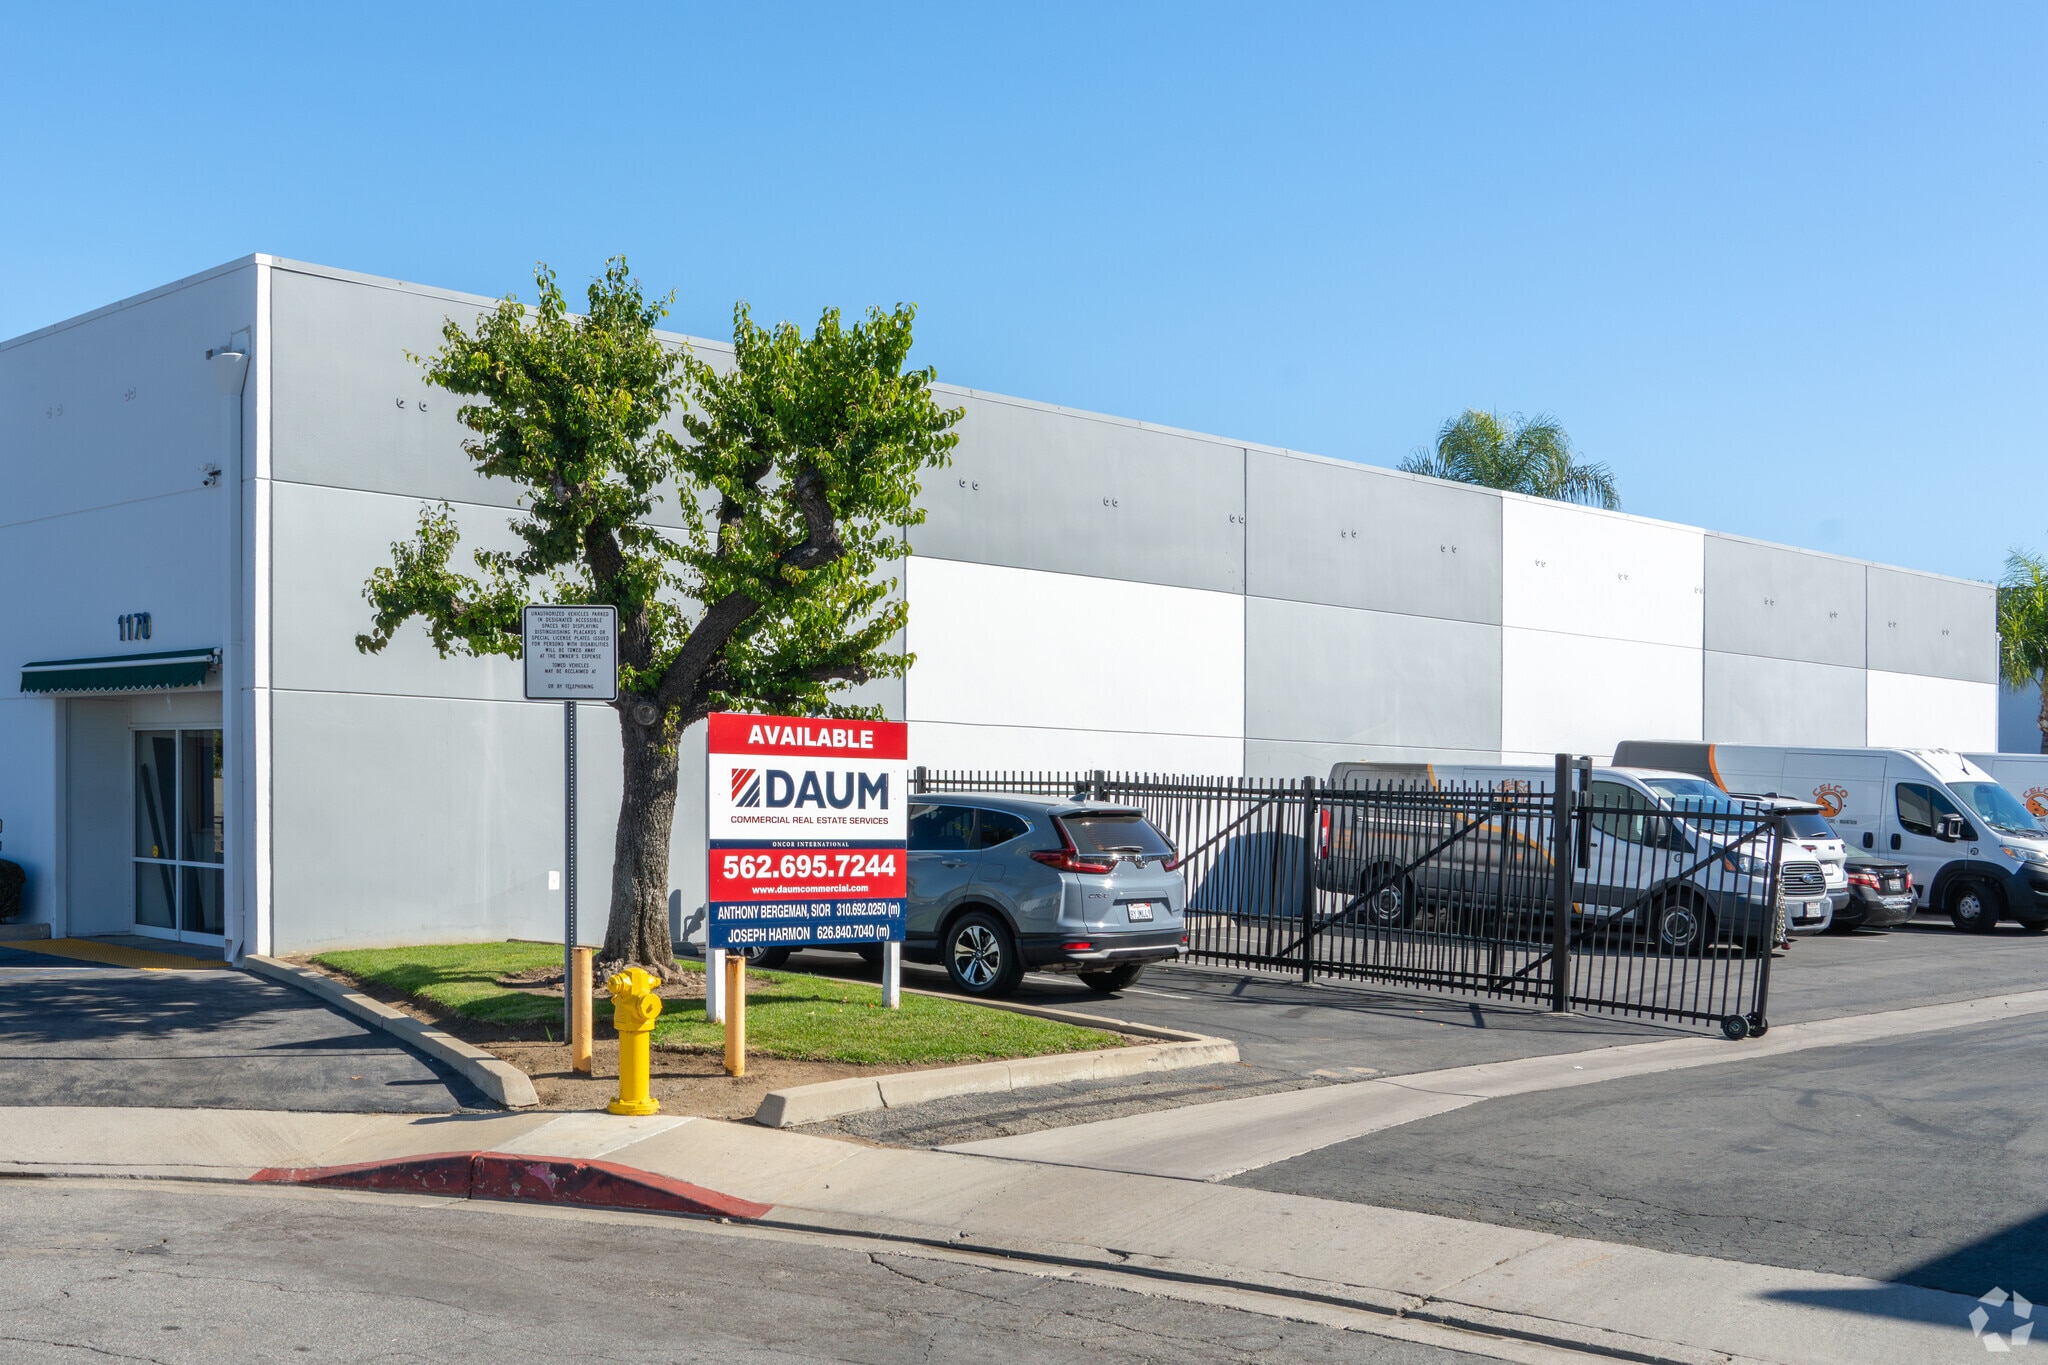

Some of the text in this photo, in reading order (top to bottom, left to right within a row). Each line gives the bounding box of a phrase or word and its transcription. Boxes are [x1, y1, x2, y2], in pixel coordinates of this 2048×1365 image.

[118, 612, 152, 641] 1170
[748, 725, 873, 748] AVAILABLE
[766, 769, 888, 809] DAUM
[1813, 783, 1848, 798] CELCO
[723, 855, 896, 879] 562.695.7244
[752, 884, 868, 894] www.daumcommercial.com
[718, 902, 900, 920] ANTHONY BERGEMAN, SIOR 310.692.0250 (m)
[728, 925, 889, 943] JOSEPH HARMON 626.840.7040 (m)
